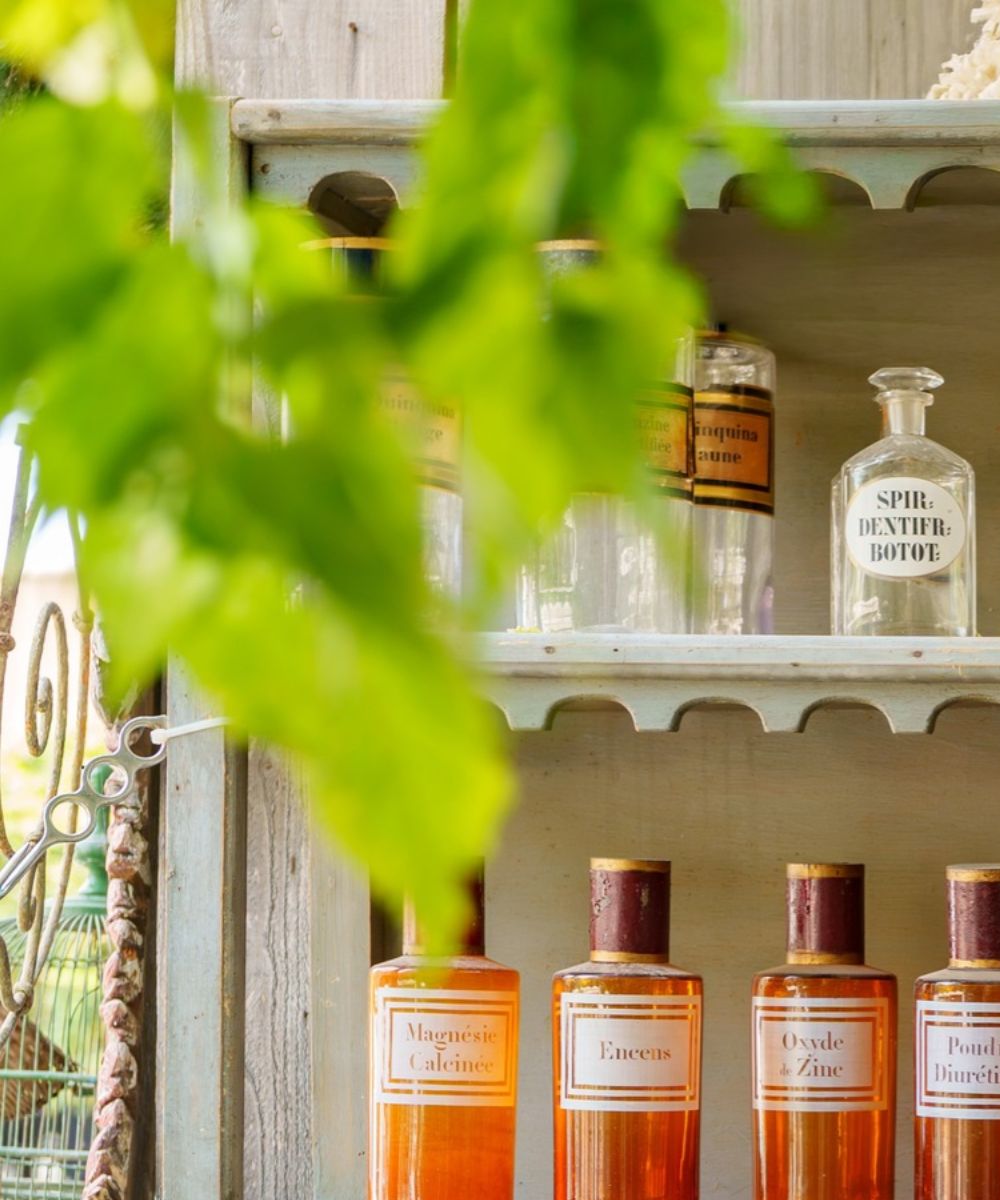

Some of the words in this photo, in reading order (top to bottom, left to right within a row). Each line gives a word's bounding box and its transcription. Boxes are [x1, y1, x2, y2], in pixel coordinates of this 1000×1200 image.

[406, 1022, 497, 1051] Magnésie
[782, 1030, 845, 1051] Oxyde
[598, 1040, 672, 1061] Encens
[796, 1056, 844, 1078] Zinc
